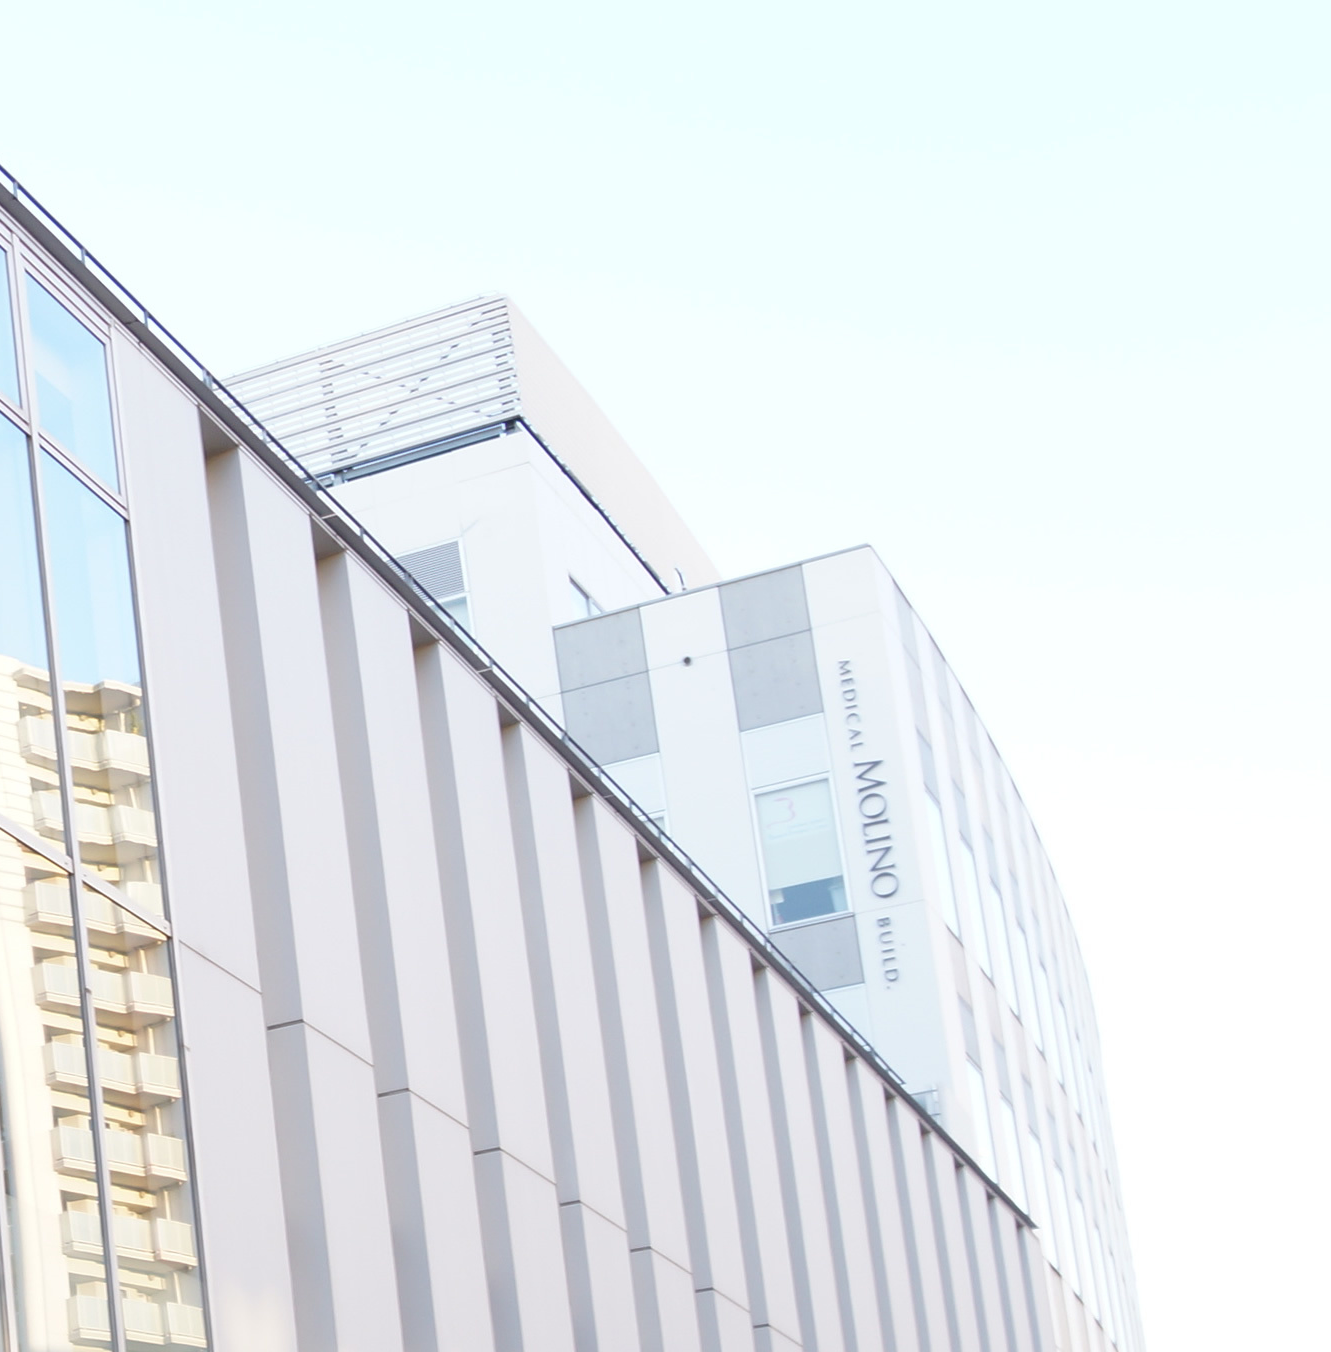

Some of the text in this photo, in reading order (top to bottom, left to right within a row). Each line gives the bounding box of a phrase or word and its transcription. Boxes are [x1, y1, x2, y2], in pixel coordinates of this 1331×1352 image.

[838, 658, 900, 990] MEDICAL MOLINO BUILD.
